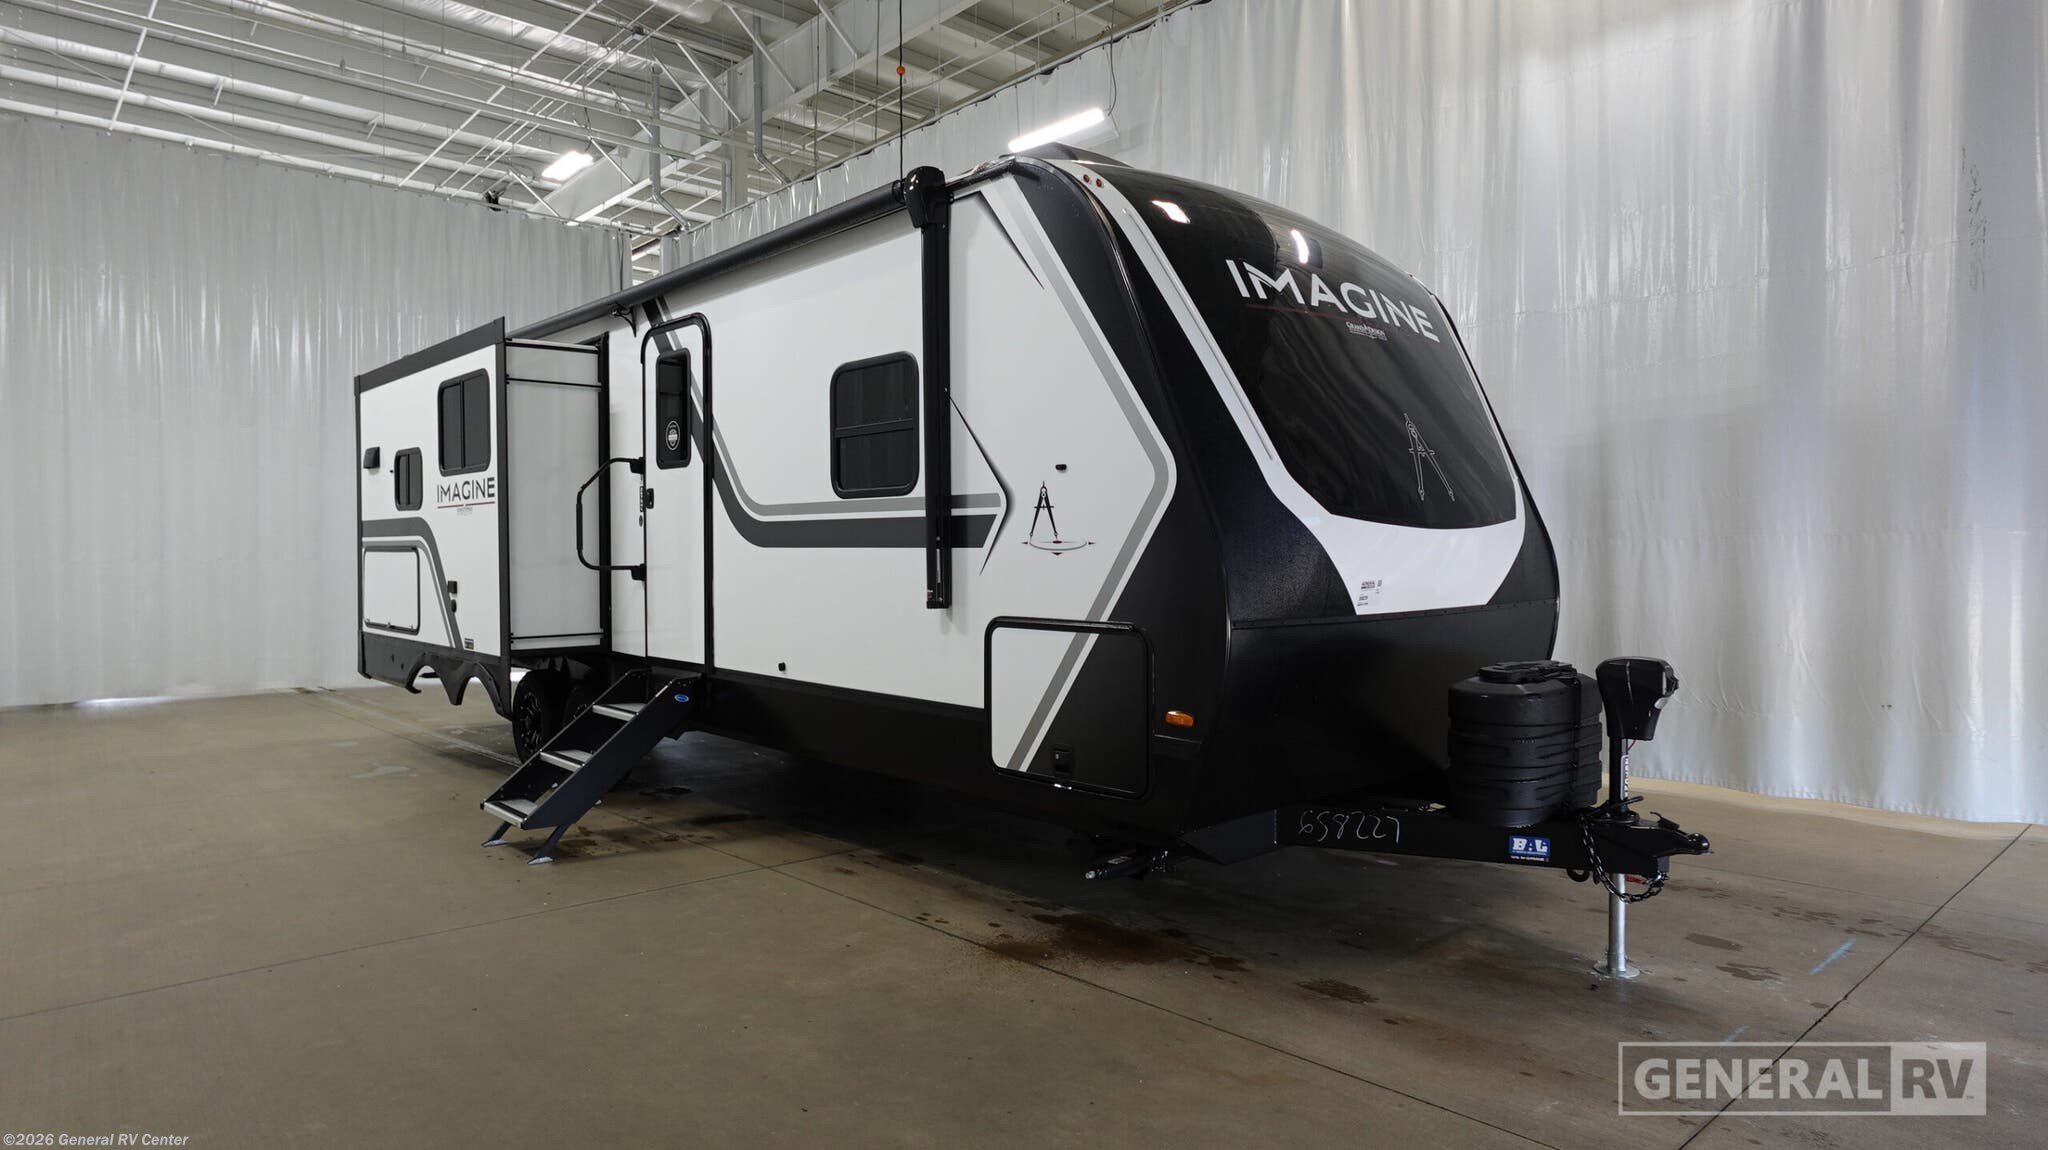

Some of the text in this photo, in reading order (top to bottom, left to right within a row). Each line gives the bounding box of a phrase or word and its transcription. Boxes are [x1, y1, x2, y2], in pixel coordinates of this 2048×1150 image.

[1225, 259, 1440, 343] IMAGINE
[437, 477, 495, 503] IMAGINE
[1299, 810, 1399, 843] 658227
